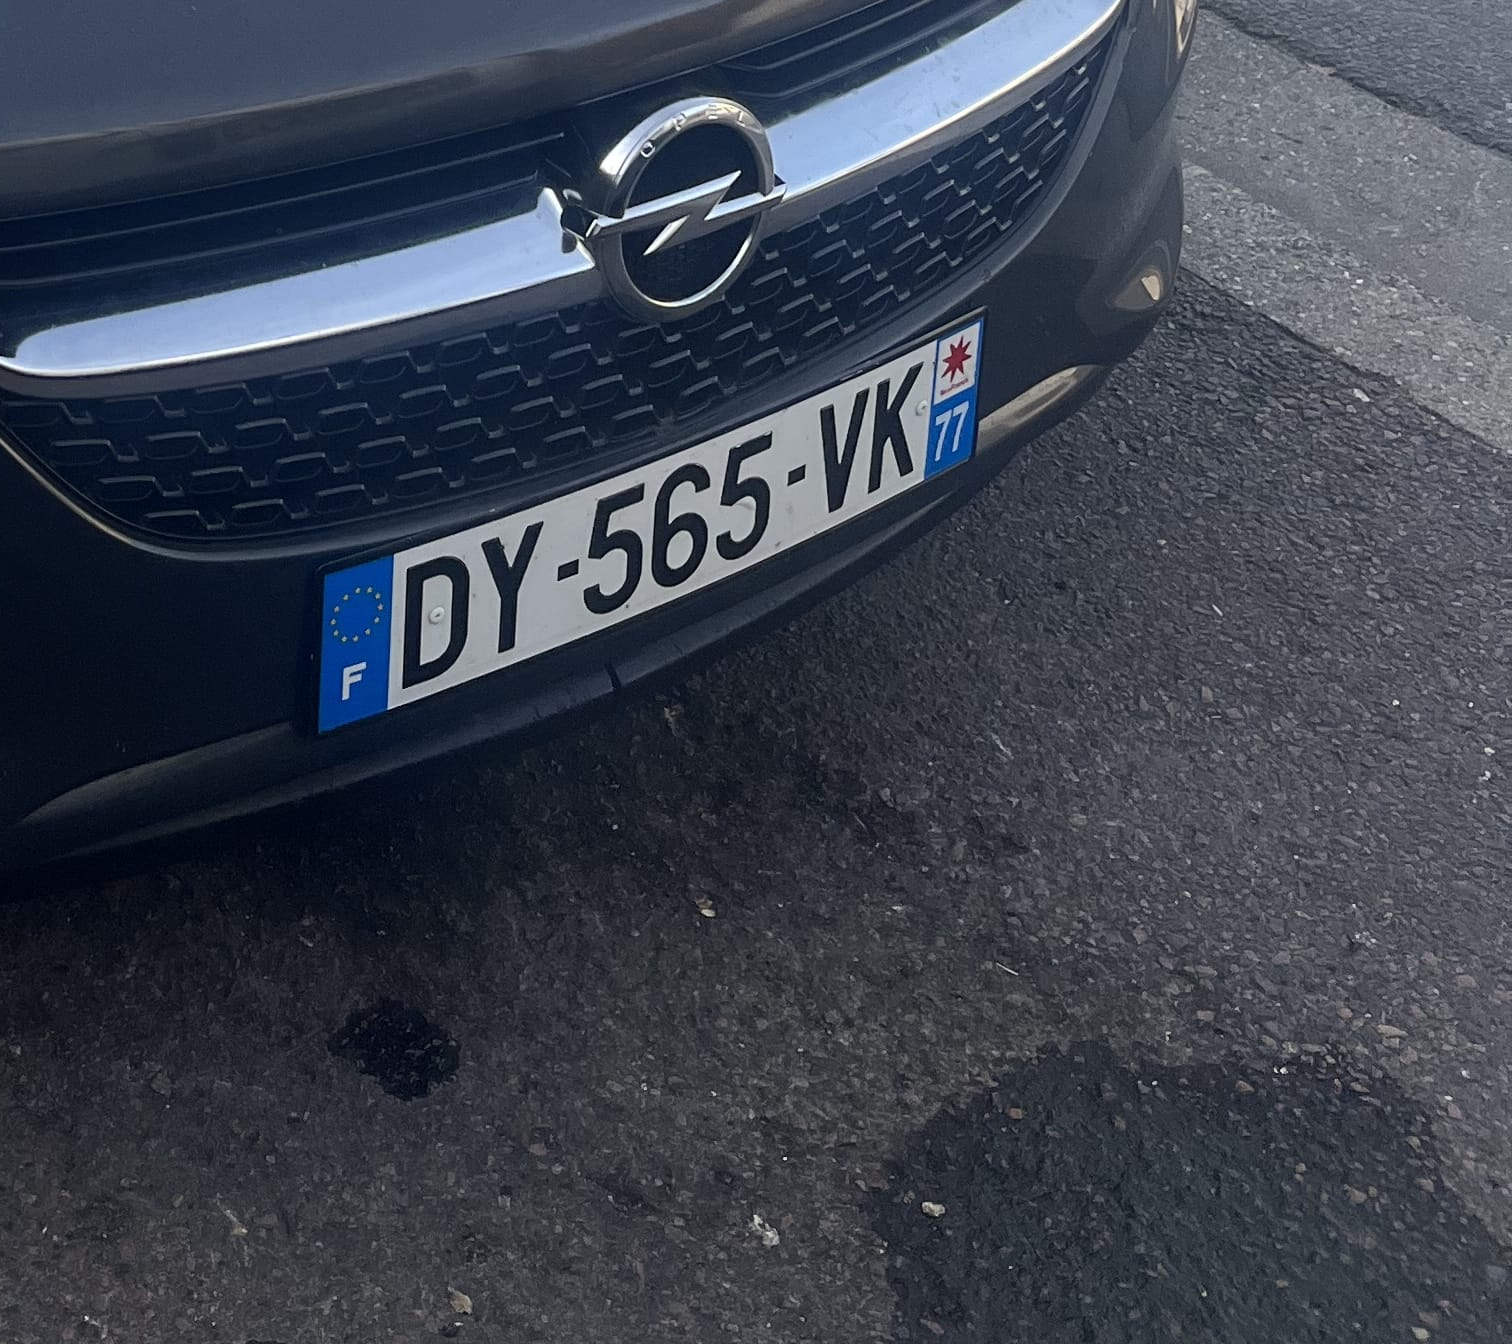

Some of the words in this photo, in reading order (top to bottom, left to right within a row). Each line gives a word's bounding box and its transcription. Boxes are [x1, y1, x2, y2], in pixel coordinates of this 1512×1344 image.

[640, 104, 747, 158] OPEL
[341, 662, 366, 701] F
[402, 361, 924, 690] DY-565-VK
[935, 401, 969, 462] 77
